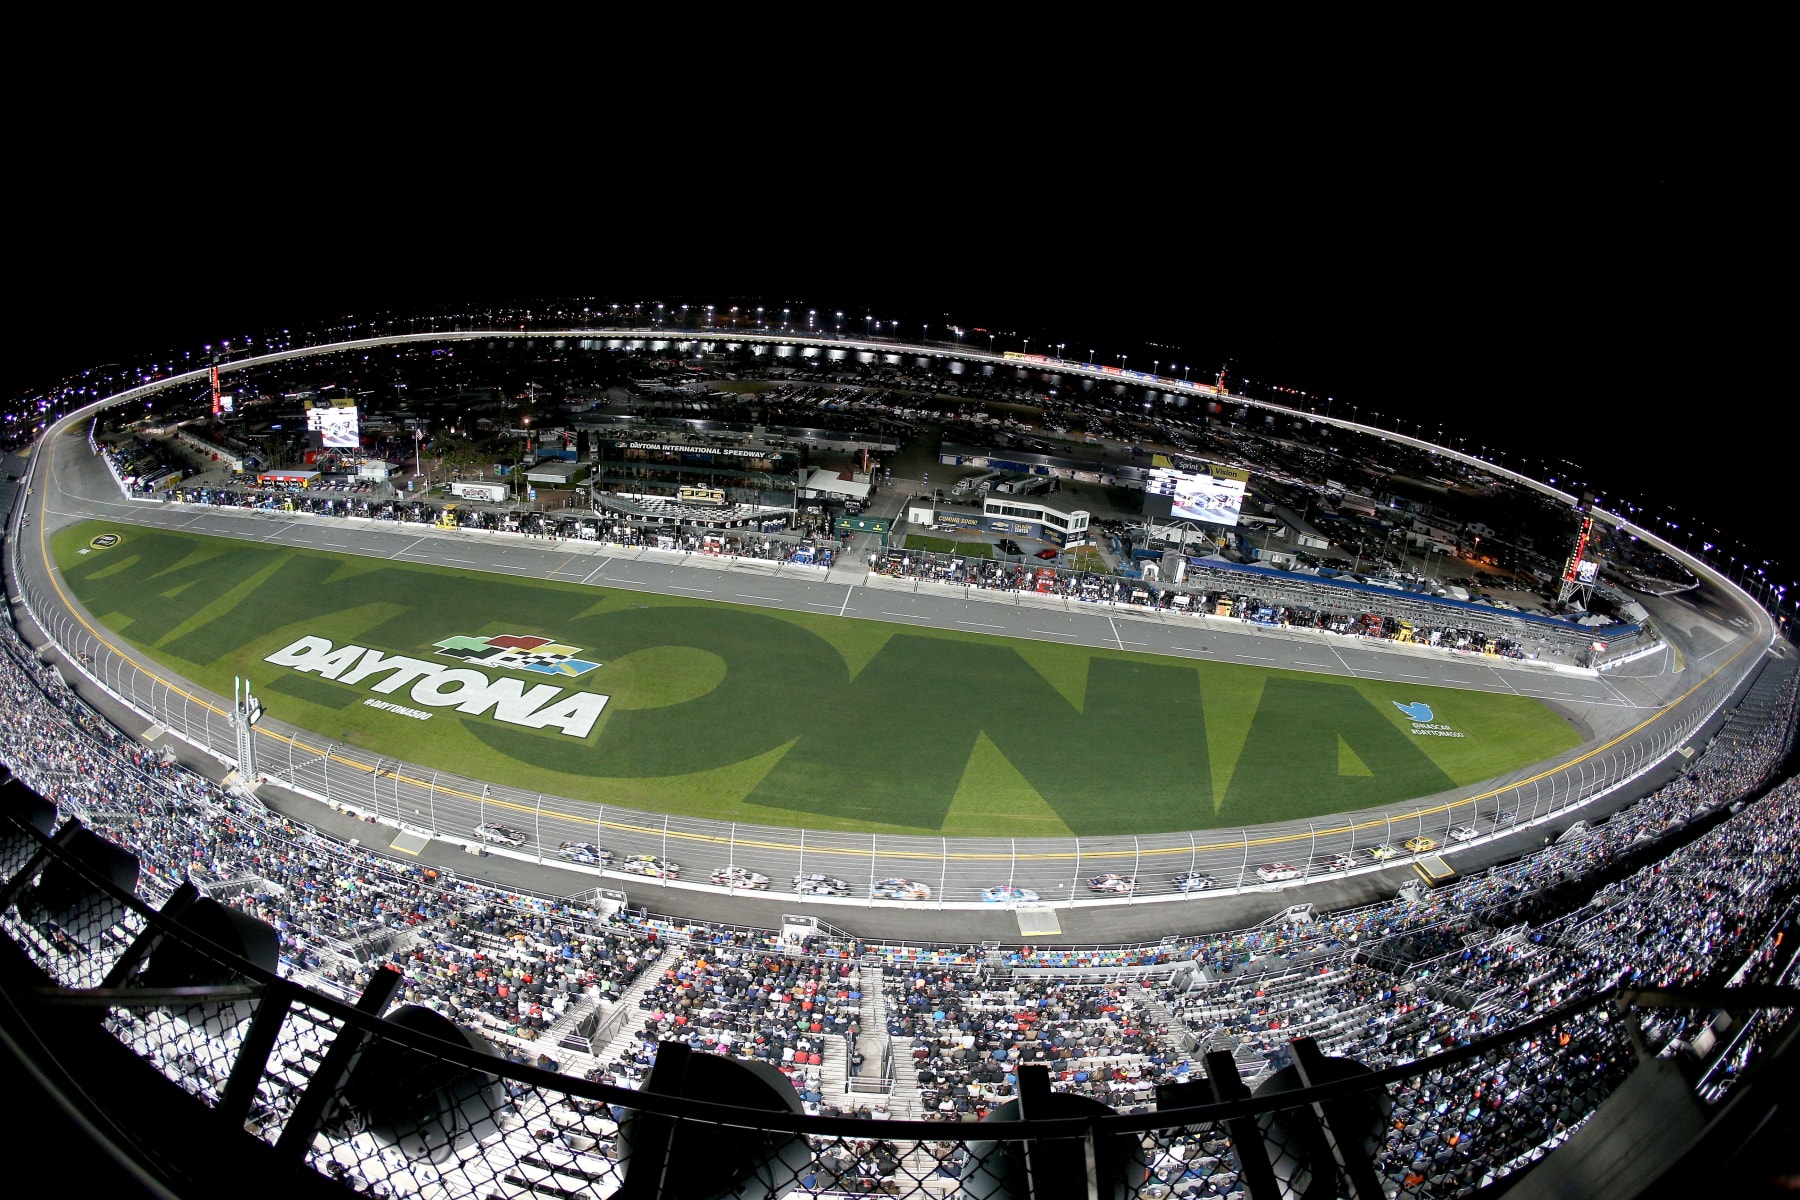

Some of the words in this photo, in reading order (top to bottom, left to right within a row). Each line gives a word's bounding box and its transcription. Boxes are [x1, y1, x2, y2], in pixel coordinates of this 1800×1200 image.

[629, 441, 661, 450] DAYTONA
[662, 444, 722, 455] INTERNATIONAL
[723, 448, 766, 459] SPEEDWAY
[1179, 461, 1199, 471] Sprint
[1215, 467, 1238, 478] Vision
[938, 515, 960, 524] COMING
[263, 634, 610, 738] DAYTONA
[362, 698, 434, 721] #DAYTONA500
[1411, 723, 1452, 731] @NASCAR
[1411, 729, 1464, 738] #DAYTONA500
